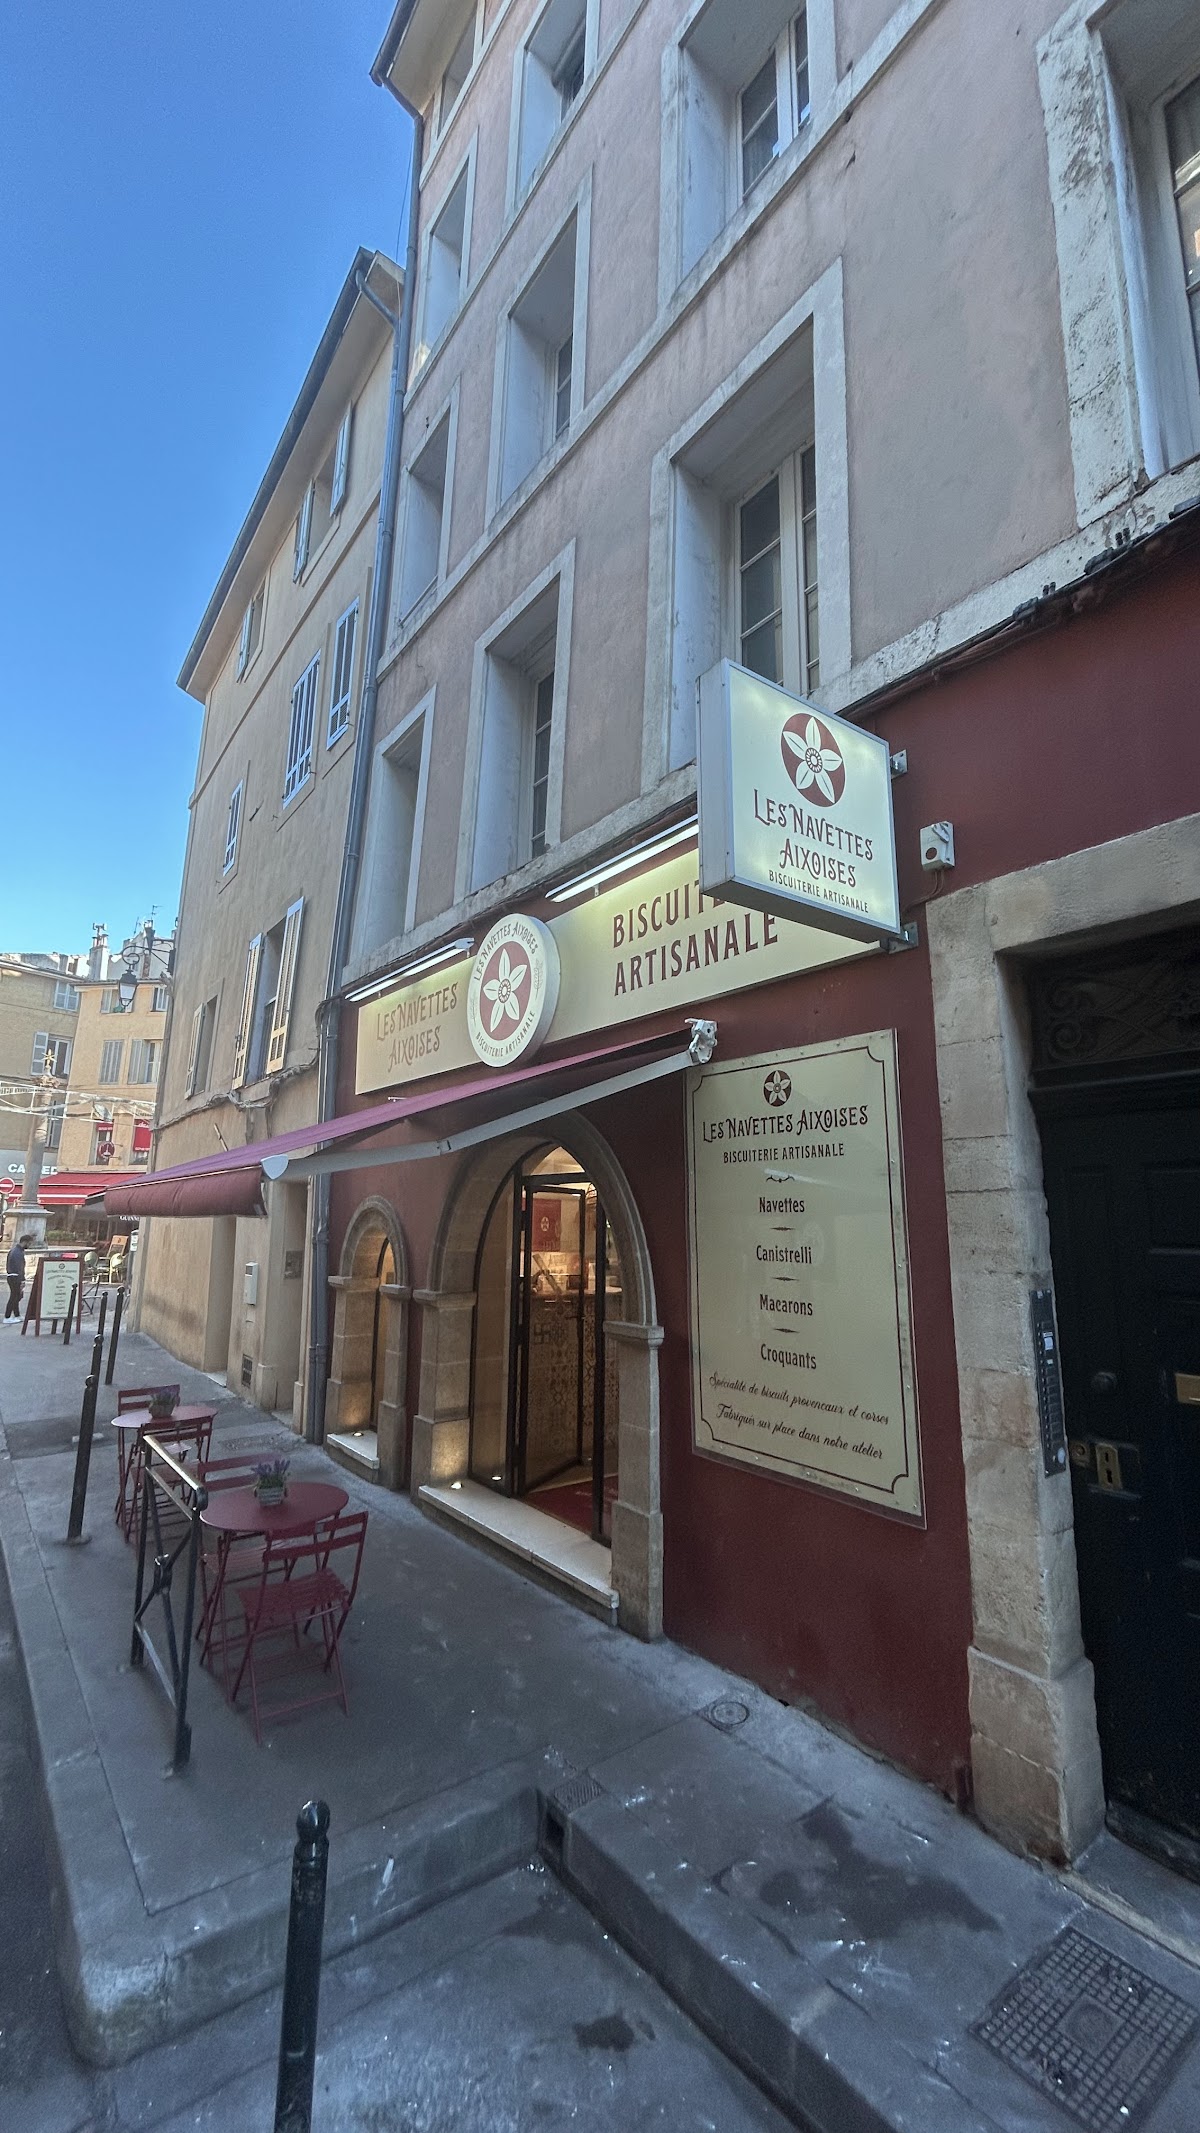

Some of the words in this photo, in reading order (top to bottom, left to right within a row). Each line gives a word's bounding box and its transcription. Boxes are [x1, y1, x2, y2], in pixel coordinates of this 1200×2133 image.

[753, 788, 787, 827] LES
[789, 803, 873, 861] NAVETTES
[779, 838, 856, 888] AIXOISES
[613, 879, 725, 948] BISCUIT
[768, 870, 821, 897] BISCUITERIE
[823, 889, 869, 914] ARTISANALE
[474, 959, 485, 981] LES
[481, 923, 512, 961] NAVETTES
[511, 921, 539, 955] AIXOISES
[614, 912, 778, 996] ARTISANALE
[376, 1009, 396, 1041] LES
[396, 981, 459, 1032] NAVETTES
[476, 1031, 504, 1057] BISCUITERIE
[505, 1011, 536, 1054] ARTISANALE
[388, 1025, 441, 1073] AIXOISES
[703, 1121, 724, 1143] LES
[725, 1113, 793, 1140] NAVETTES
[796, 1104, 869, 1136] AIXOISES
[723, 1147, 779, 1164] BISCUITERIE
[782, 1143, 845, 1160] ARTISANALE
[759, 1196, 805, 1213] Navettes
[756, 1245, 813, 1265] Canistrelli
[759, 1293, 813, 1316] Macarons
[760, 1343, 817, 1370] Croquants
[748, 1383, 759, 1395] de
[761, 1385, 789, 1402] biscuits
[848, 1405, 859, 1418] et
[861, 1411, 889, 1425] corses
[716, 1403, 755, 1428] Fabriqués
[757, 1419, 771, 1430] sur
[771, 1421, 796, 1435] place
[798, 1427, 821, 1443] dans
[823, 1436, 849, 1450] notre
[851, 1441, 883, 1460] atelier
